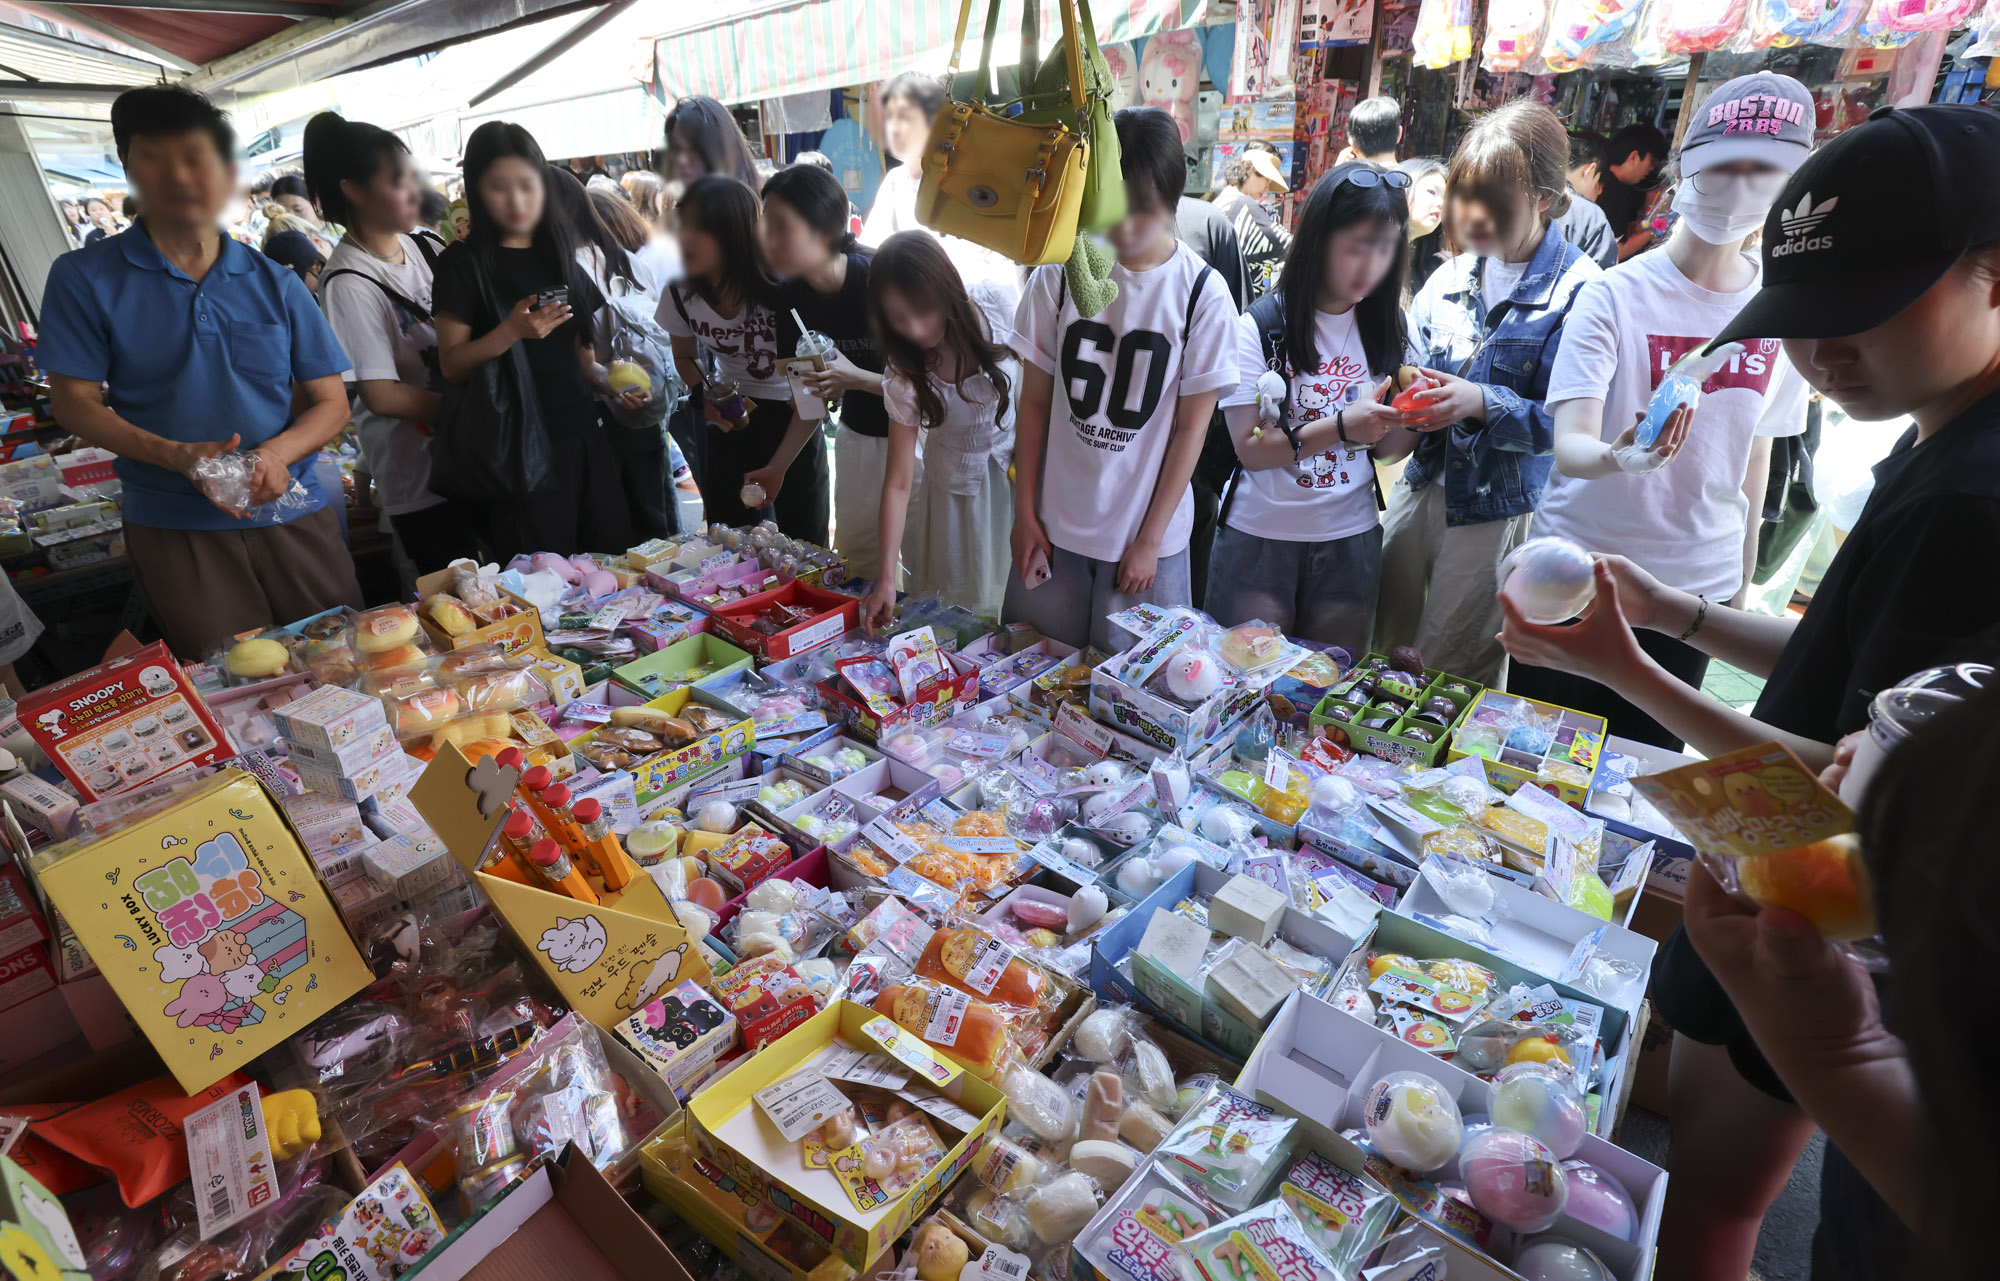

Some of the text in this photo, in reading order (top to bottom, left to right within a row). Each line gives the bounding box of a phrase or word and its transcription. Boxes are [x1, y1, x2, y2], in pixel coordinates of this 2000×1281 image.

[1707, 94, 1805, 128] BOSTON
[1771, 234, 1833, 258] adidas
[1061, 318, 1173, 430] 60
[1093, 440, 1110, 450] SURF
[1110, 443, 1126, 453] CLUB
[1097, 427, 1137, 443] ARCHIVE
[67, 709, 94, 726] 스누피
[93, 698, 119, 715] 무드등
[117, 687, 144, 702] 꾸미기
[68, 680, 125, 712] SNOOPY
[192, 831, 264, 922] 박스
[120, 893, 162, 947] LUCKY BOX
[134, 857, 221, 948] 랜덤
[608, 957, 631, 979] 우드
[629, 933, 659, 956] 펜슬
[628, 1017, 643, 1036] CAT
[1311, 1150, 1365, 1190] 스트레스백
[1290, 1160, 1365, 1220] 왁뿌볼
[331, 1236, 361, 1275] 랜덤 키링
